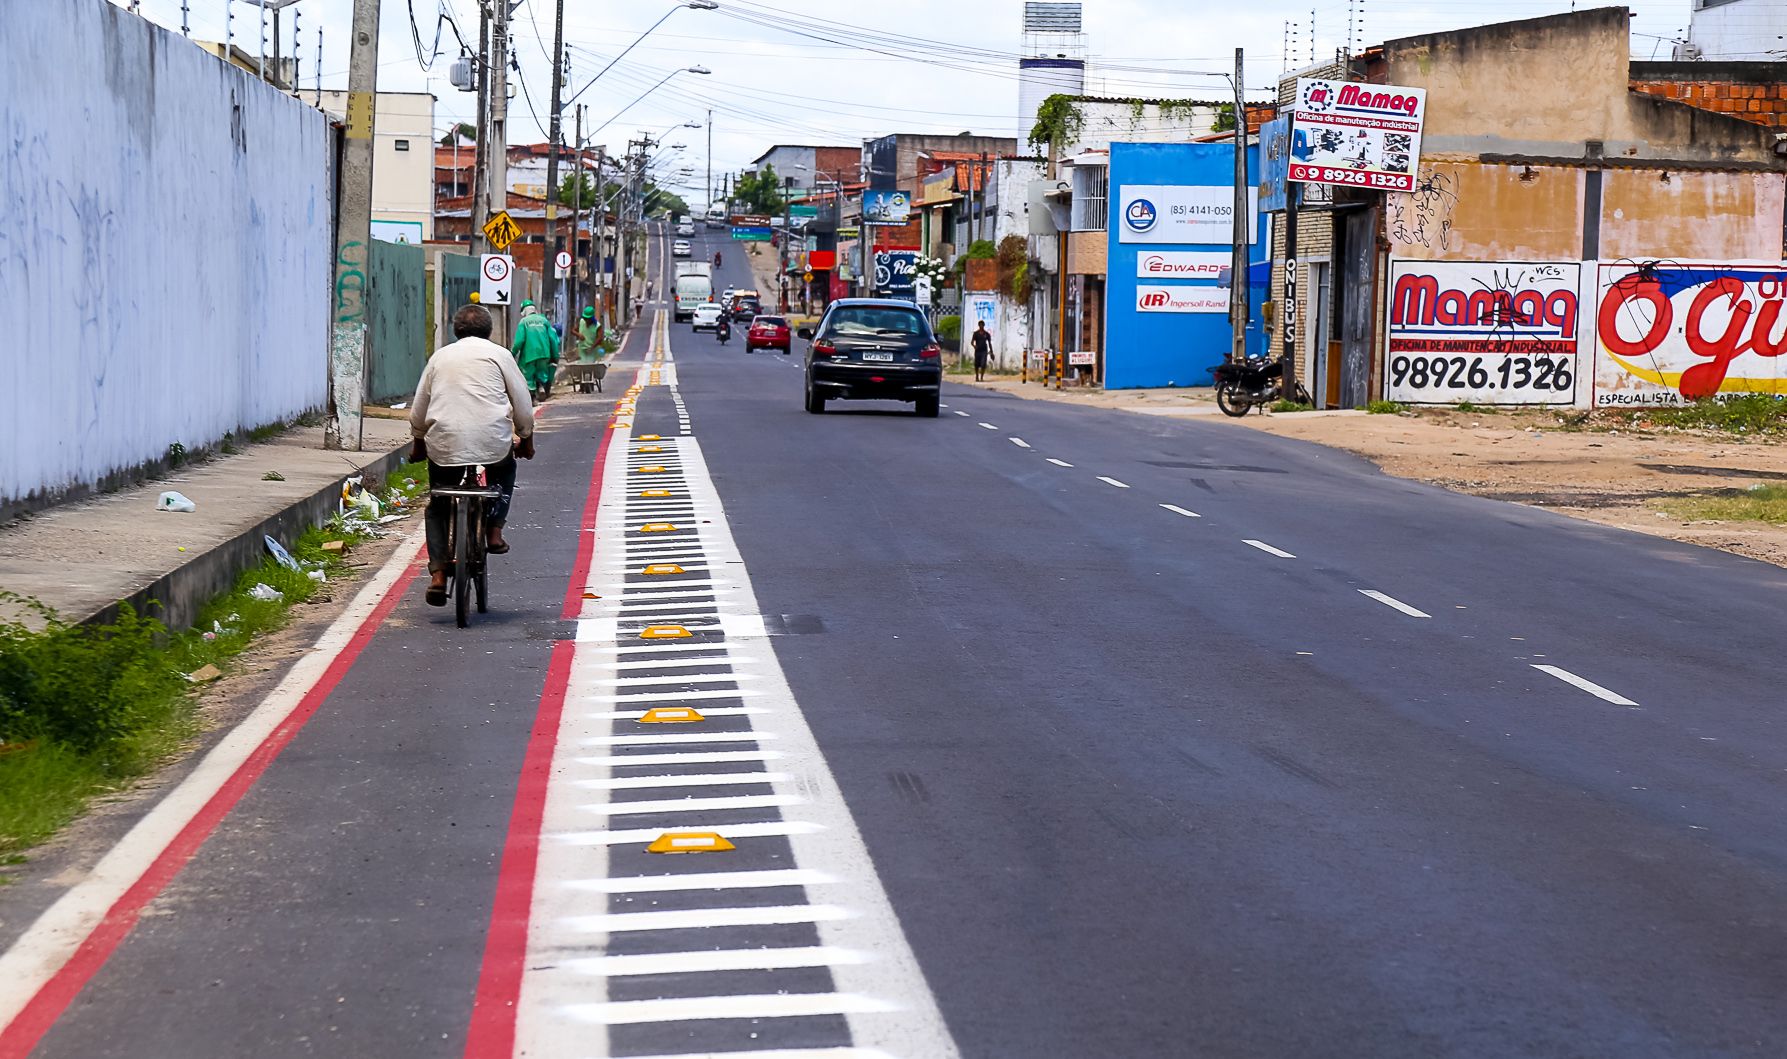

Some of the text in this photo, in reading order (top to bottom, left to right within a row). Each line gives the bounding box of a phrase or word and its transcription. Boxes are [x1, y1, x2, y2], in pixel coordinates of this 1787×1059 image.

[1337, 85, 1418, 116] Mamaq
[1297, 112, 1323, 122] Oficina
[1335, 116, 1381, 128] manutenção
[1307, 167, 1408, 188] 9 8926 1326
[1170, 205, 1187, 216] (85)
[1144, 294, 1165, 307] IR
[1170, 300, 1226, 309] Ingersoll Rand
[1284, 258, 1296, 343] ONIBUS
[1391, 273, 1577, 338] Mamaq
[1391, 340, 1428, 351] OFICINA
[1430, 340, 1441, 351] DE
[1391, 355, 1573, 392] 98926.1326
[1598, 392, 1678, 405] ESPECIALISTA
